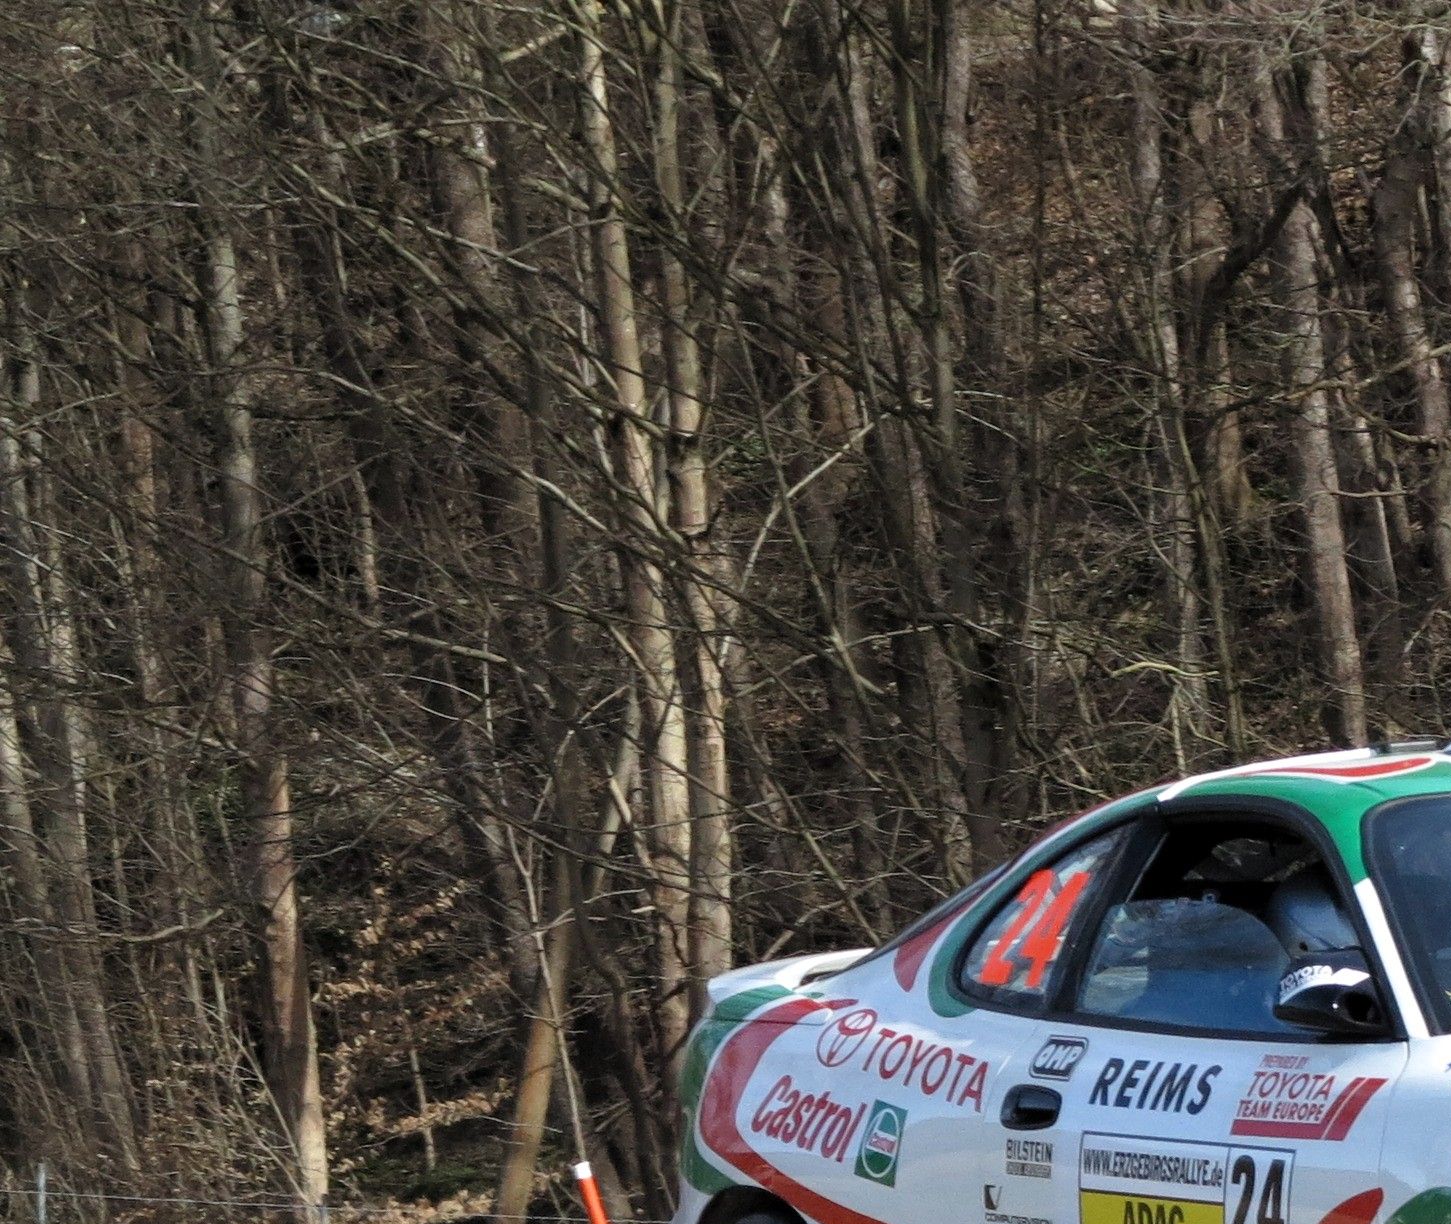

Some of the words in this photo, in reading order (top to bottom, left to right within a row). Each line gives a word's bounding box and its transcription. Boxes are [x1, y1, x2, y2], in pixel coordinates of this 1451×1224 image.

[979, 868, 1091, 989] 24
[1280, 965, 1333, 992] TOYOTA
[862, 1027, 989, 1112] TOYOTA
[1034, 1043, 1083, 1072] OMP
[1088, 1057, 1223, 1116] REIMS
[1247, 1071, 1336, 1100] TOYOTA
[751, 1075, 868, 1163] Castrol
[1236, 1100, 1272, 1118] TEAM
[1272, 1102, 1326, 1121] EUROPE
[1006, 1139, 1053, 1163] BILSTEIN
[1083, 1149, 1223, 1188] WWW.ERZGEBIRGSRALLYE.de
